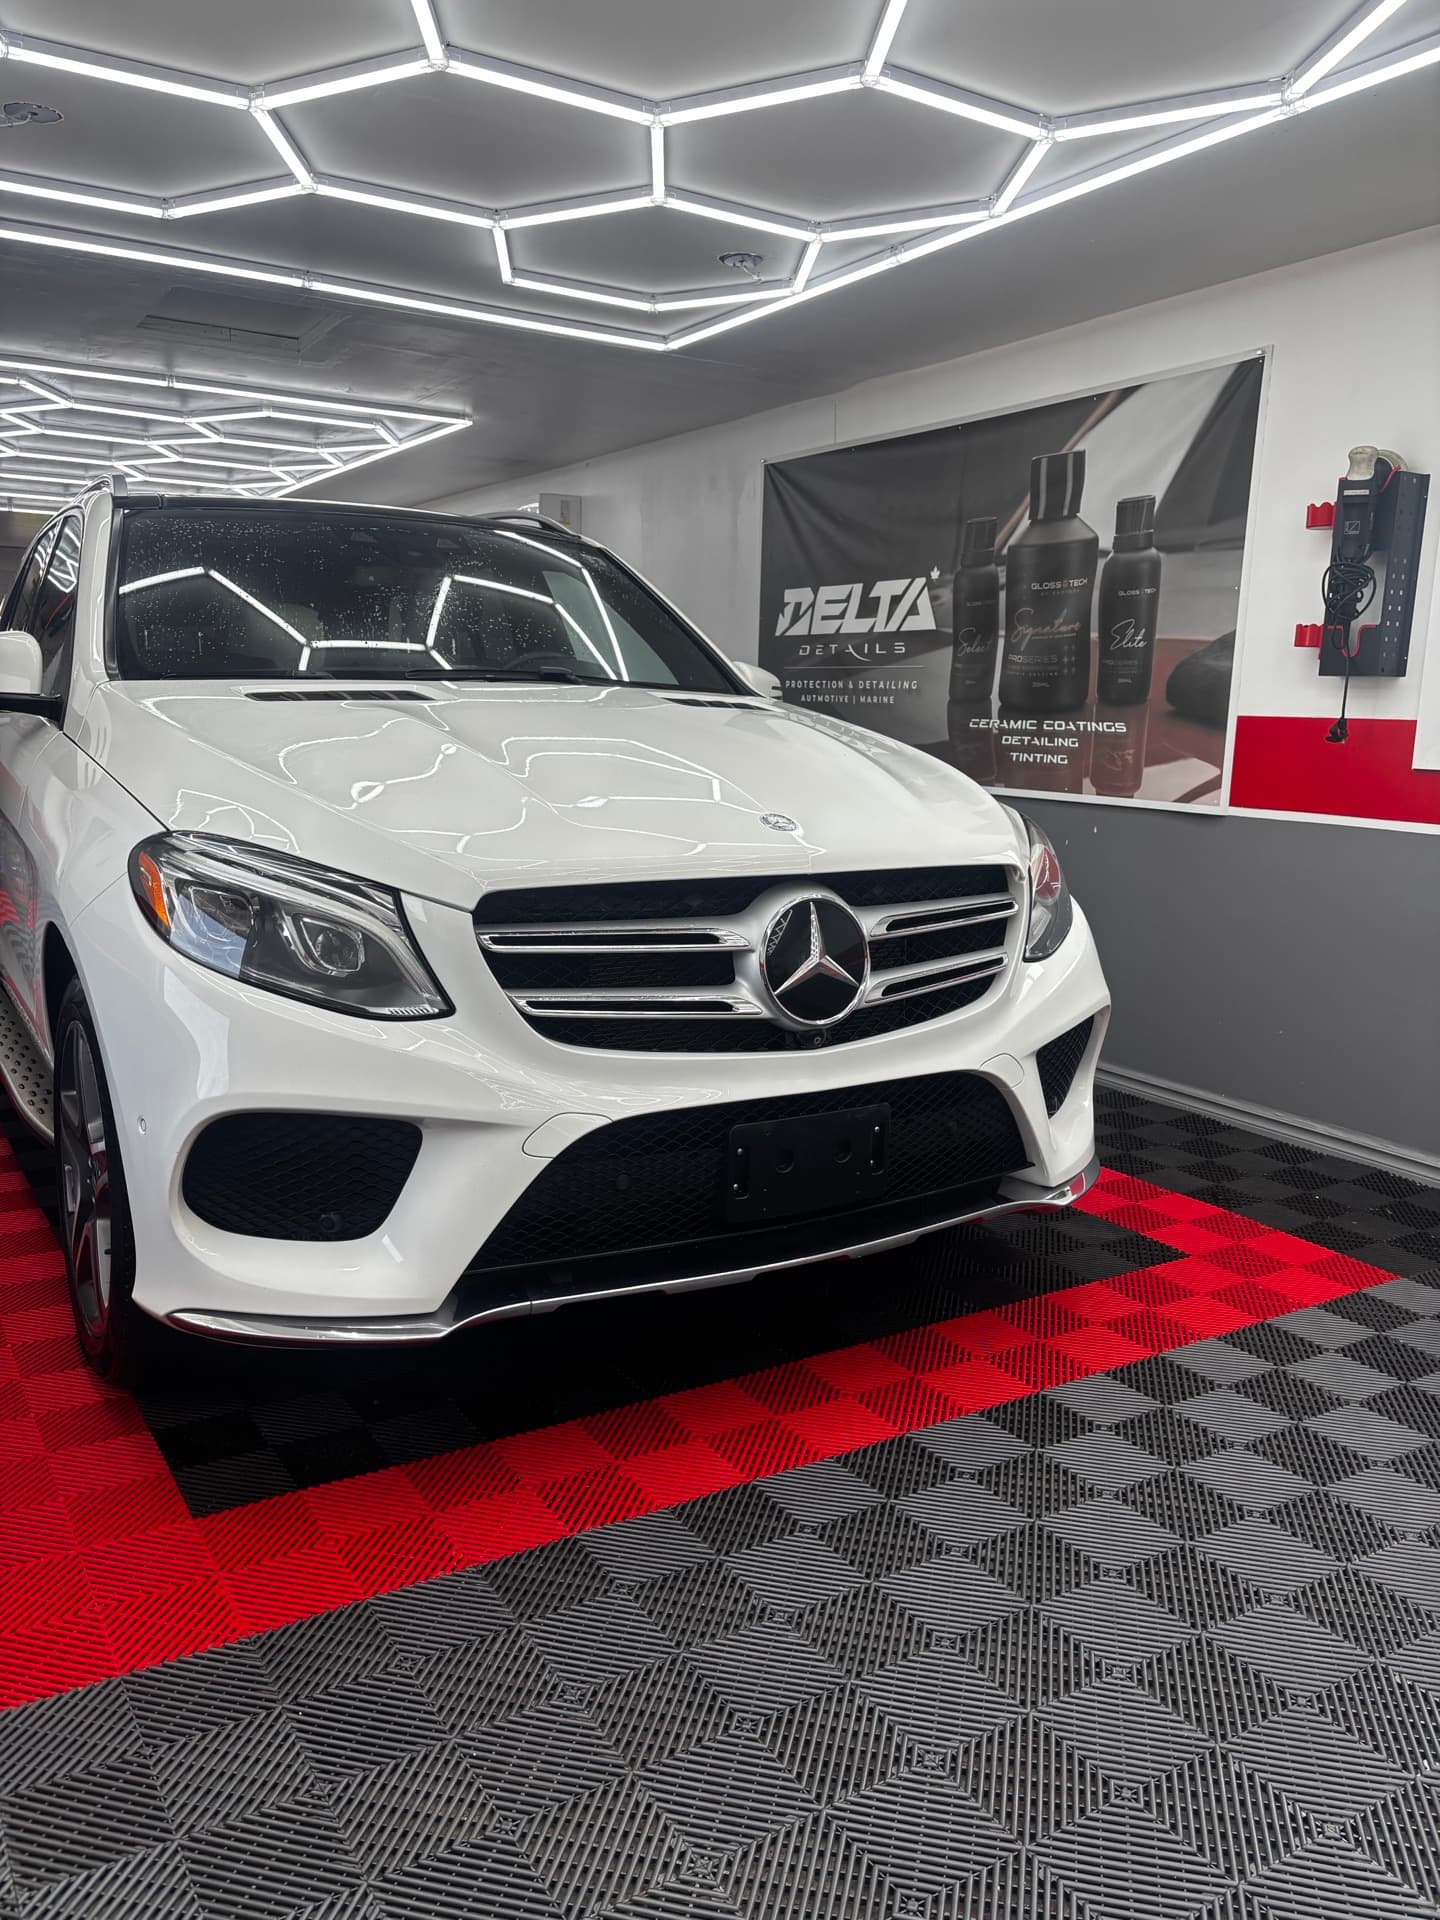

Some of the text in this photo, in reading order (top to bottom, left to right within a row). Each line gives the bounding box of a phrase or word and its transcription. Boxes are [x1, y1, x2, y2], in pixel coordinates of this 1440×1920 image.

[1031, 582, 1062, 590] GLOSS
[775, 577, 937, 636] DELTA
[1109, 618, 1149, 650] Elite
[799, 642, 906, 662] DETAILS
[785, 680, 844, 689] PROTECTION
[858, 680, 919, 690] DETAILING
[800, 694, 849, 703] AUTMOTIVE
[859, 695, 895, 704] MARINE
[968, 718, 1127, 733] CERAMIC COATINGS
[1001, 735, 1079, 748] DETAILING
[1010, 752, 1069, 765] TINTING
